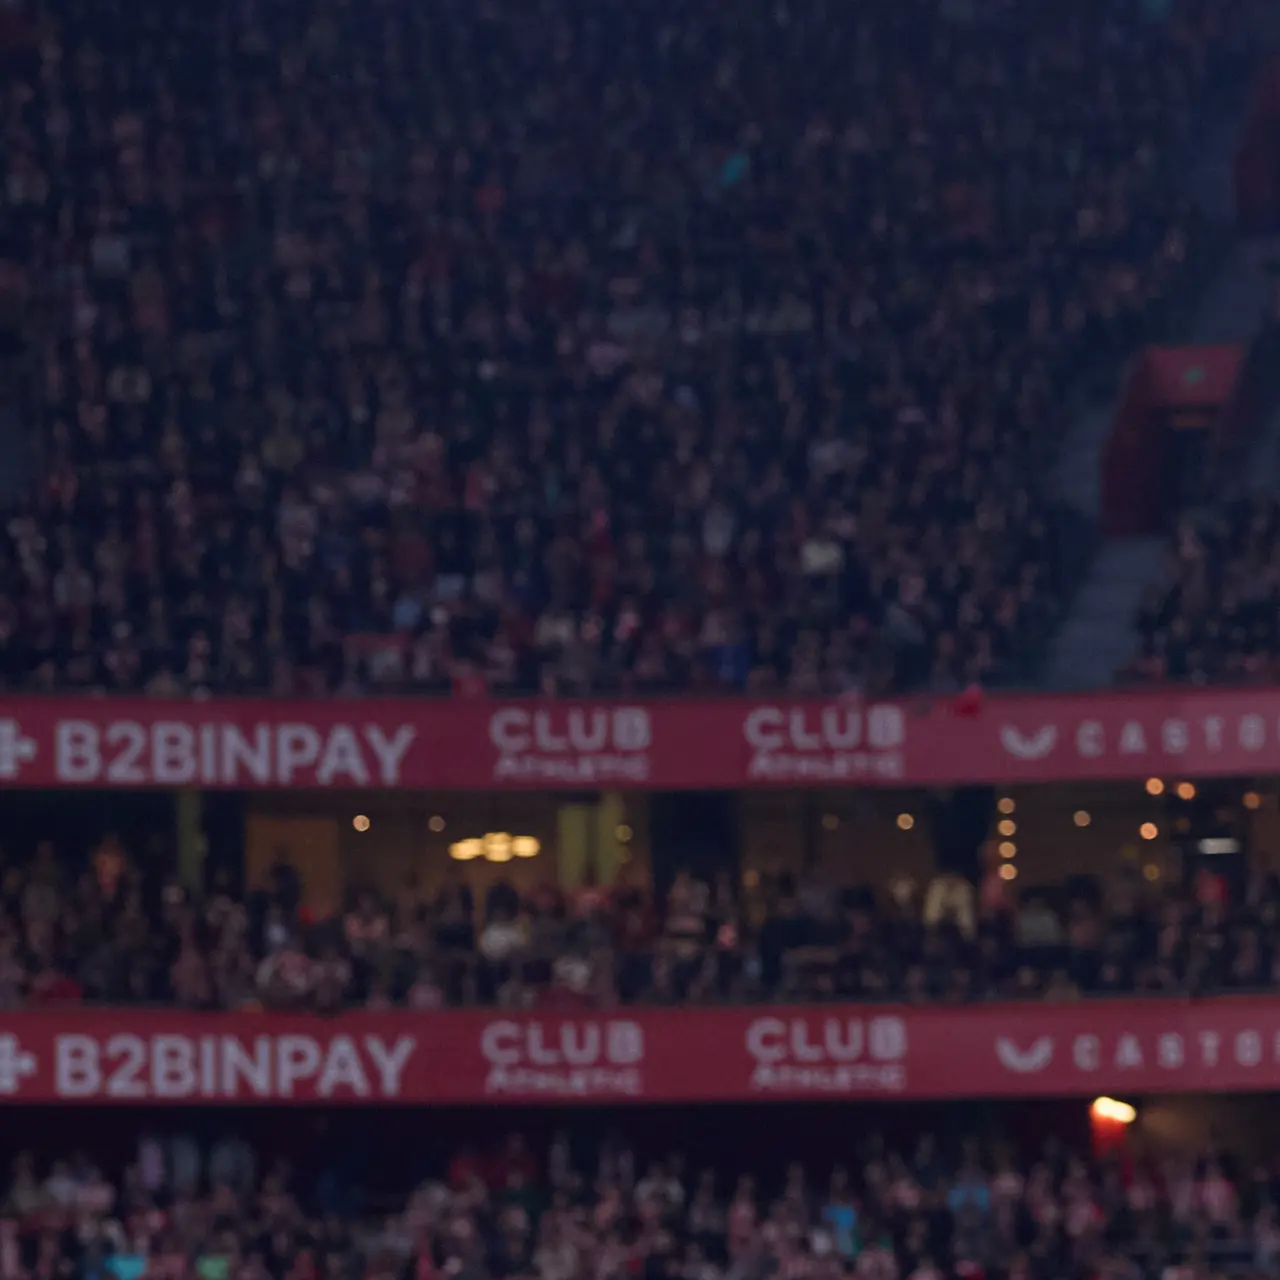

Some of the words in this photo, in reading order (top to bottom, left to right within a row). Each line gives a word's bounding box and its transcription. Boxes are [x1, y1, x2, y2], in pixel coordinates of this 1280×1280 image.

[489, 706, 652, 751] CLUB
[744, 704, 906, 750] CLUB
[56, 721, 415, 783] B2BINPAY
[481, 1020, 644, 1066] CLUB
[746, 1016, 908, 1062] CLUB
[56, 1034, 416, 1097] B2BINPAY
